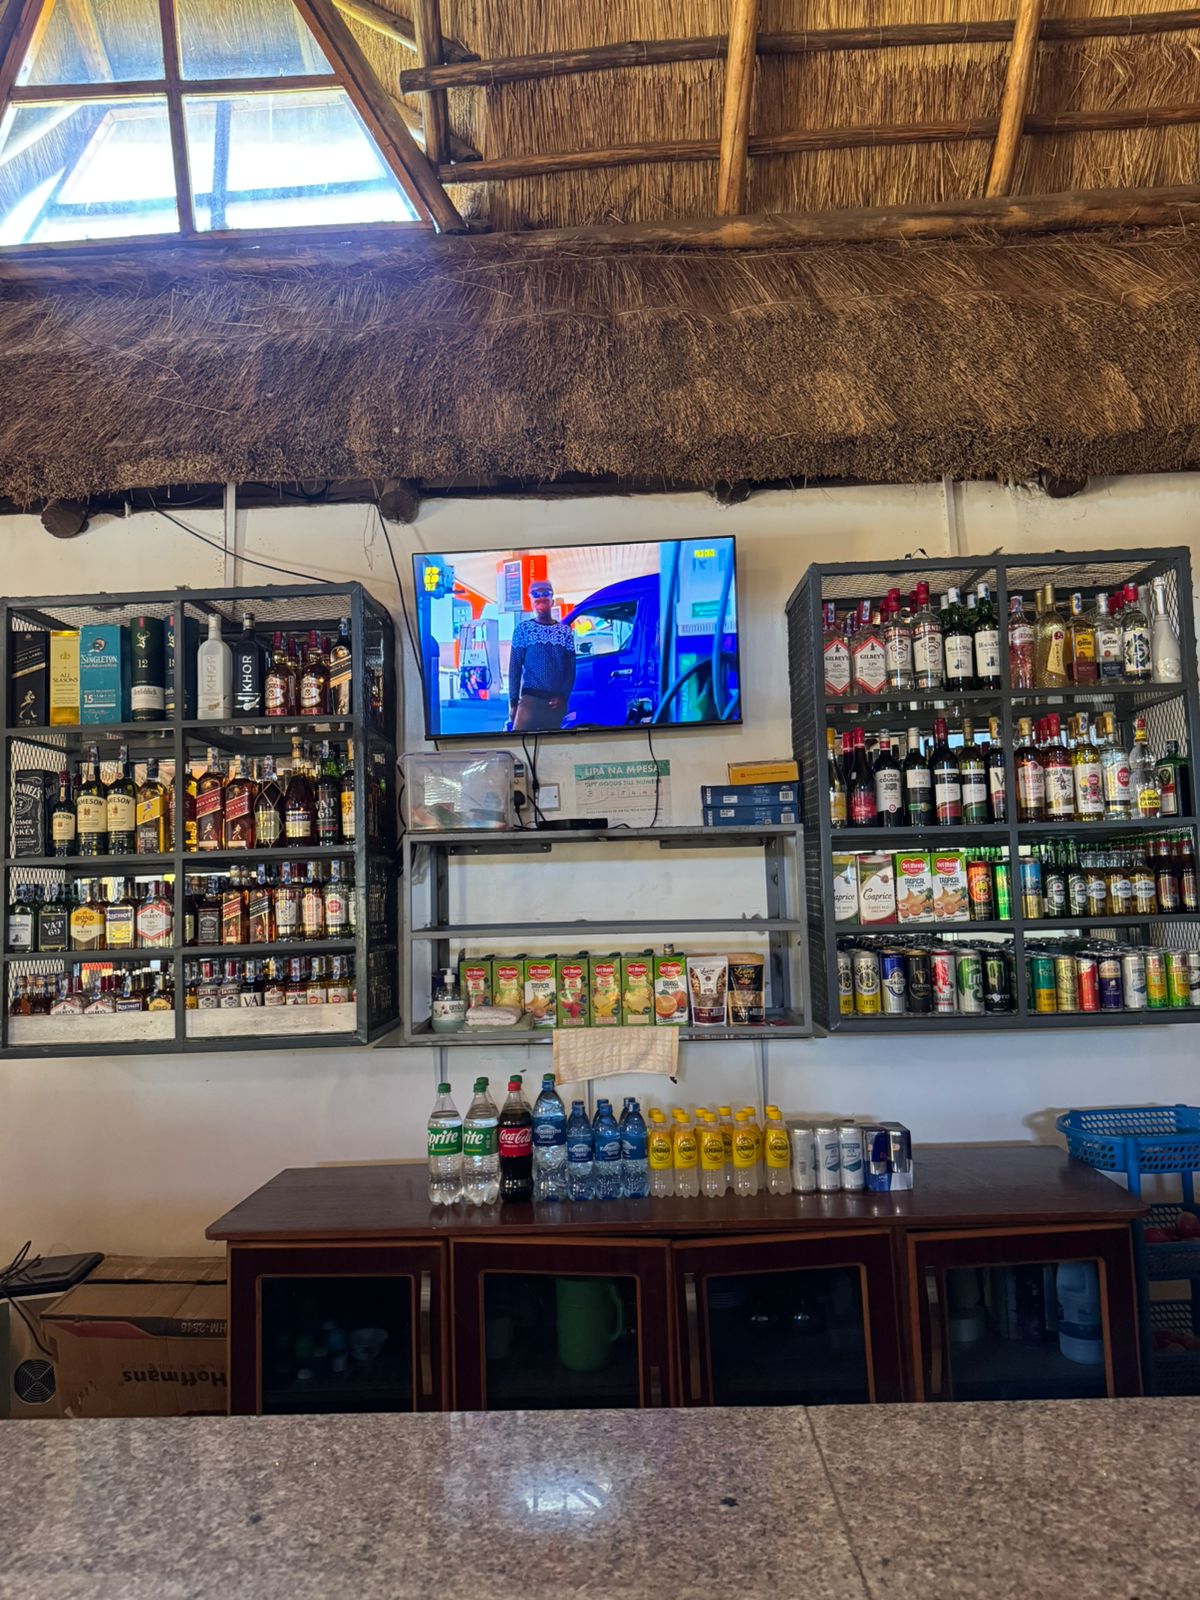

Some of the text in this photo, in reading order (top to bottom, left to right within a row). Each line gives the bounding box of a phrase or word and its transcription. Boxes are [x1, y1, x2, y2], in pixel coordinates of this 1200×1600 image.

[80, 654, 118, 664] SINGLETON
[137, 658, 149, 668] 12
[241, 655, 253, 692] KHOR
[84, 694, 94, 704] 15
[584, 767, 605, 776] LIPA
[608, 767, 623, 775] NA
[15, 783, 43, 800] ANIEL'S
[15, 828, 36, 836] SKEY
[834, 892, 855, 903] aprice
[862, 887, 893, 903] Caprice
[42, 920, 64, 930] VAT
[81, 920, 87, 929] 7
[47, 928, 61, 936] 69
[464, 1130, 483, 1145] rite
[122, 1370, 228, 1388] Hoffmans
